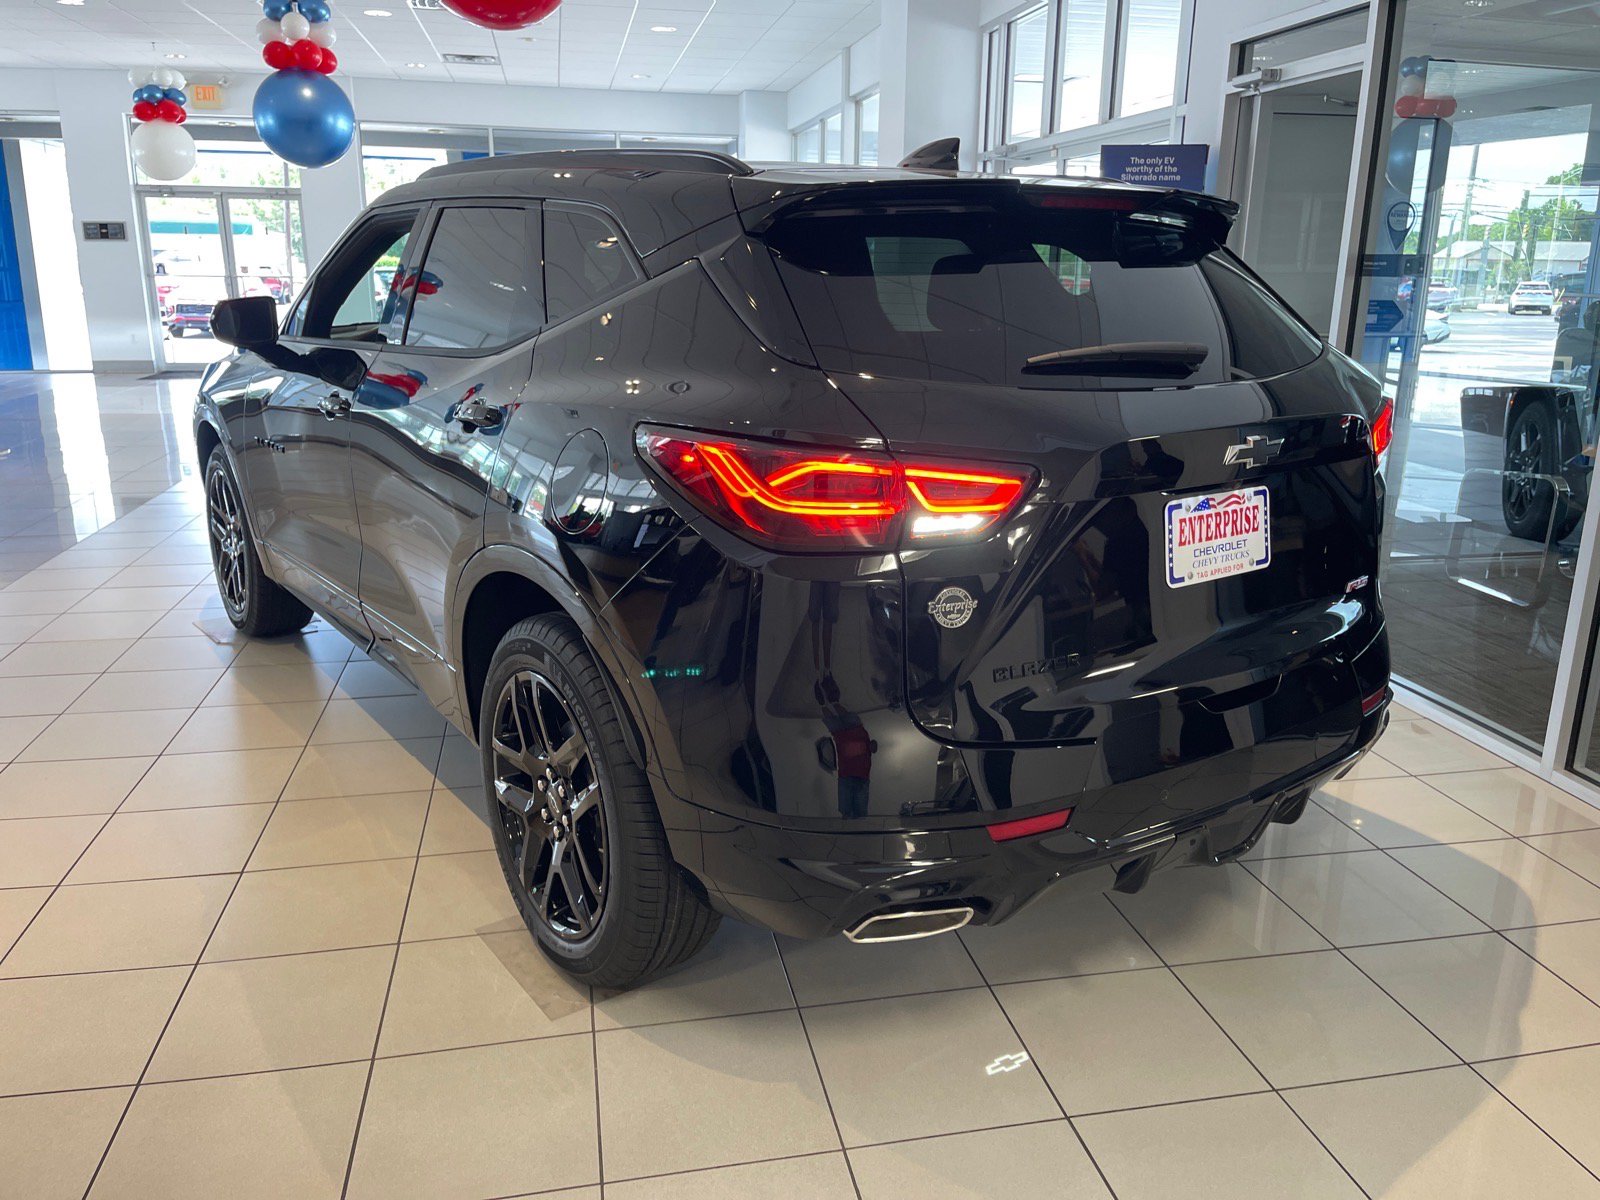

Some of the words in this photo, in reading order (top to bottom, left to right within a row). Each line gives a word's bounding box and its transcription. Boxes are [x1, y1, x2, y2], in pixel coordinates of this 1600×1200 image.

[194, 85, 216, 101] EXIT
[1125, 165, 1153, 174] worthy
[1154, 165, 1164, 173] of
[1164, 165, 1178, 173] the
[1146, 157, 1163, 166] only
[1121, 173, 1157, 181] Silverado
[1178, 504, 1260, 547] ENTERPRISE
[1193, 539, 1248, 558] CHEVROLET
[1192, 556, 1219, 569] CHEVY
[1221, 550, 1250, 563] TRUCKS
[1196, 570, 1209, 579] TAG
[1210, 566, 1232, 576] APPLIED
[1233, 563, 1244, 571] FOR
[927, 599, 978, 614] Enterprise
